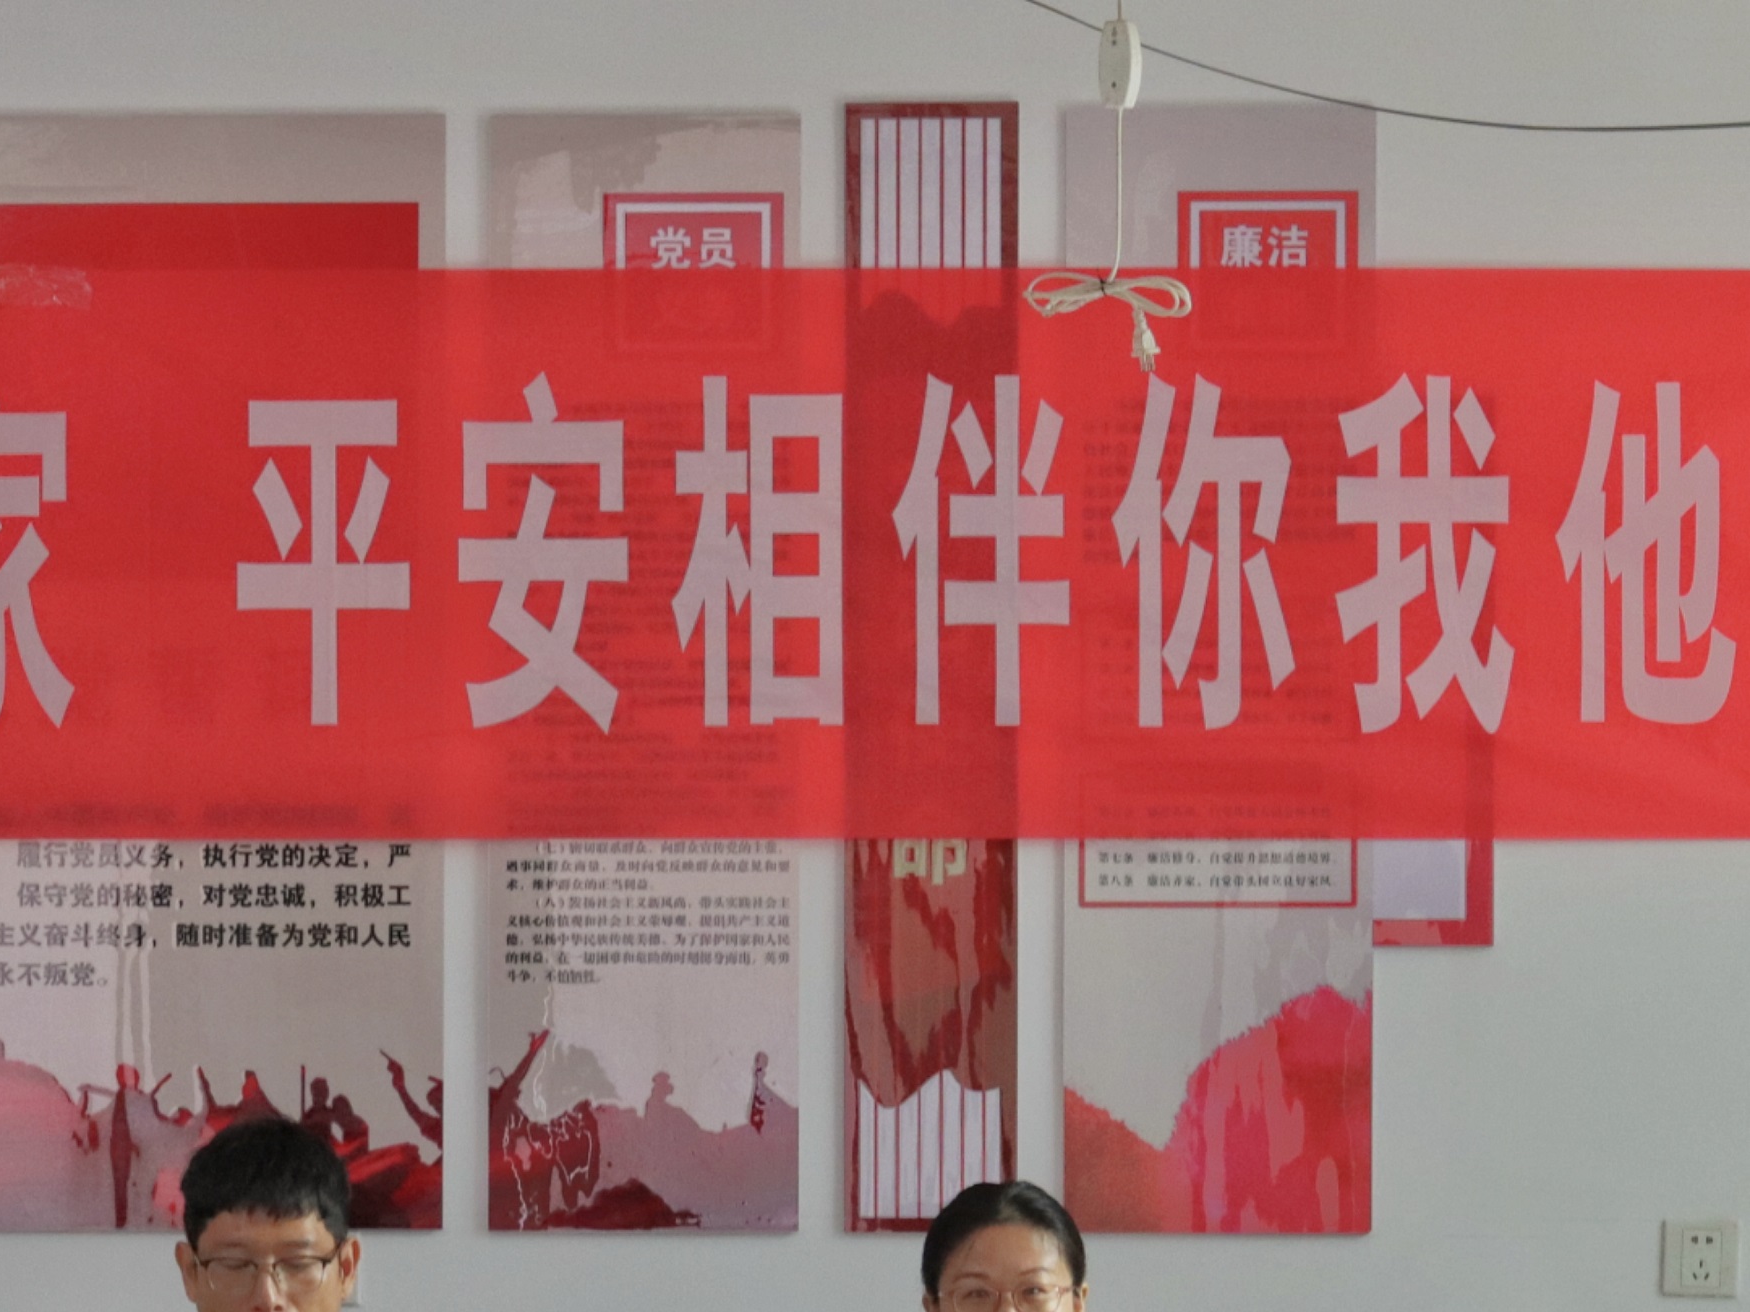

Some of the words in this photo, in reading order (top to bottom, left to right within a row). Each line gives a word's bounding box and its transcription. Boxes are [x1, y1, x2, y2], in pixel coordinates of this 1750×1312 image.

[650, 226, 736, 269] 党员
[1220, 224, 1309, 267] 廉洁
[237, 373, 1737, 733] 平安相伴你我他
